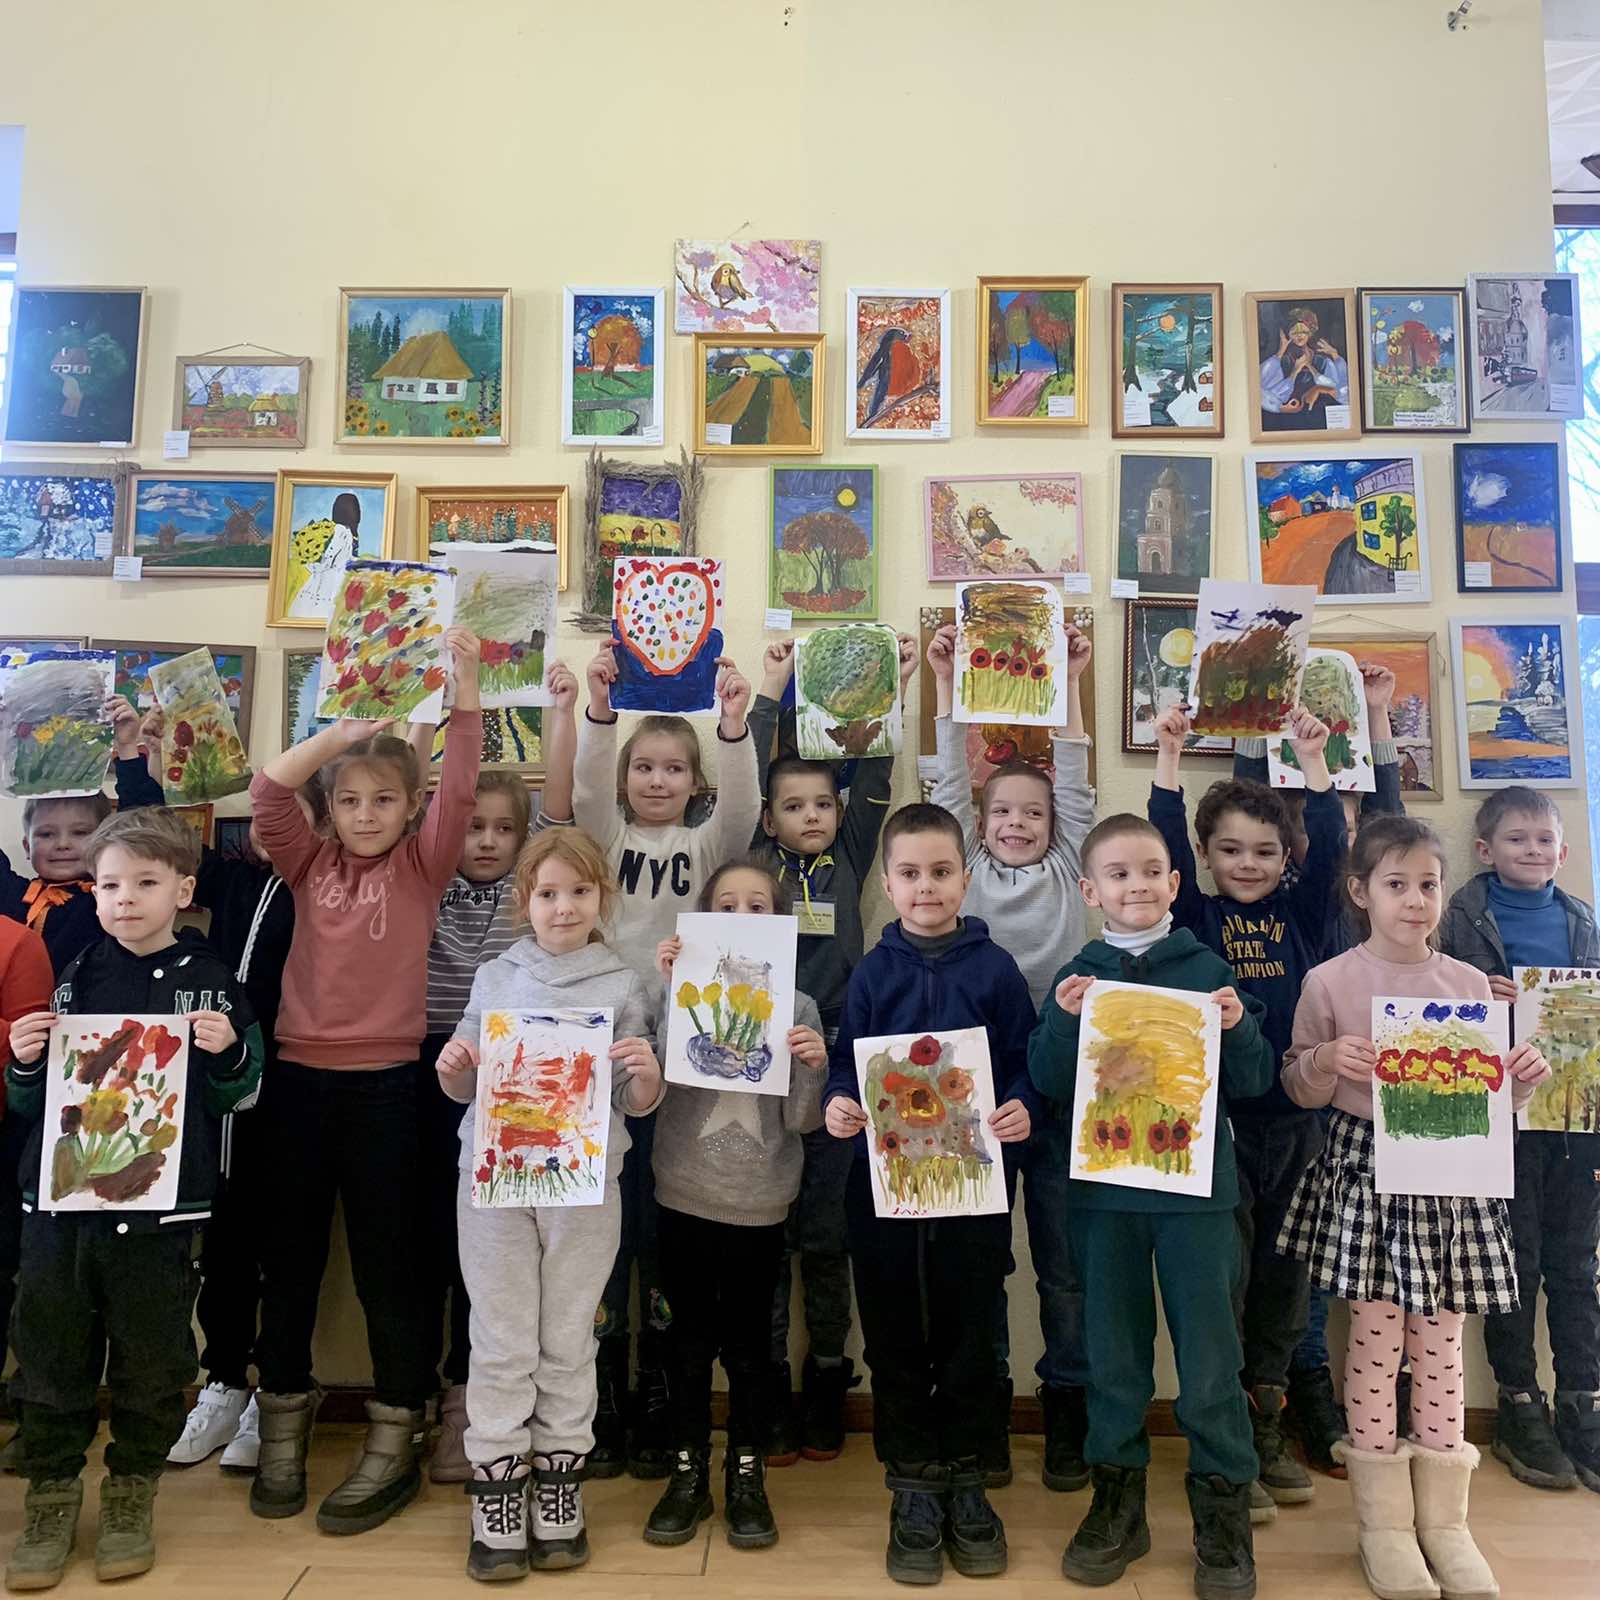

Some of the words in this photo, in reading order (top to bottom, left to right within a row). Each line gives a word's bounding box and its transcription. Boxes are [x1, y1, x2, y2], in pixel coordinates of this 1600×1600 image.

[618, 849, 690, 899] NYC
[1226, 940, 1266, 960] STATE
[1232, 960, 1285, 979] AMPION
